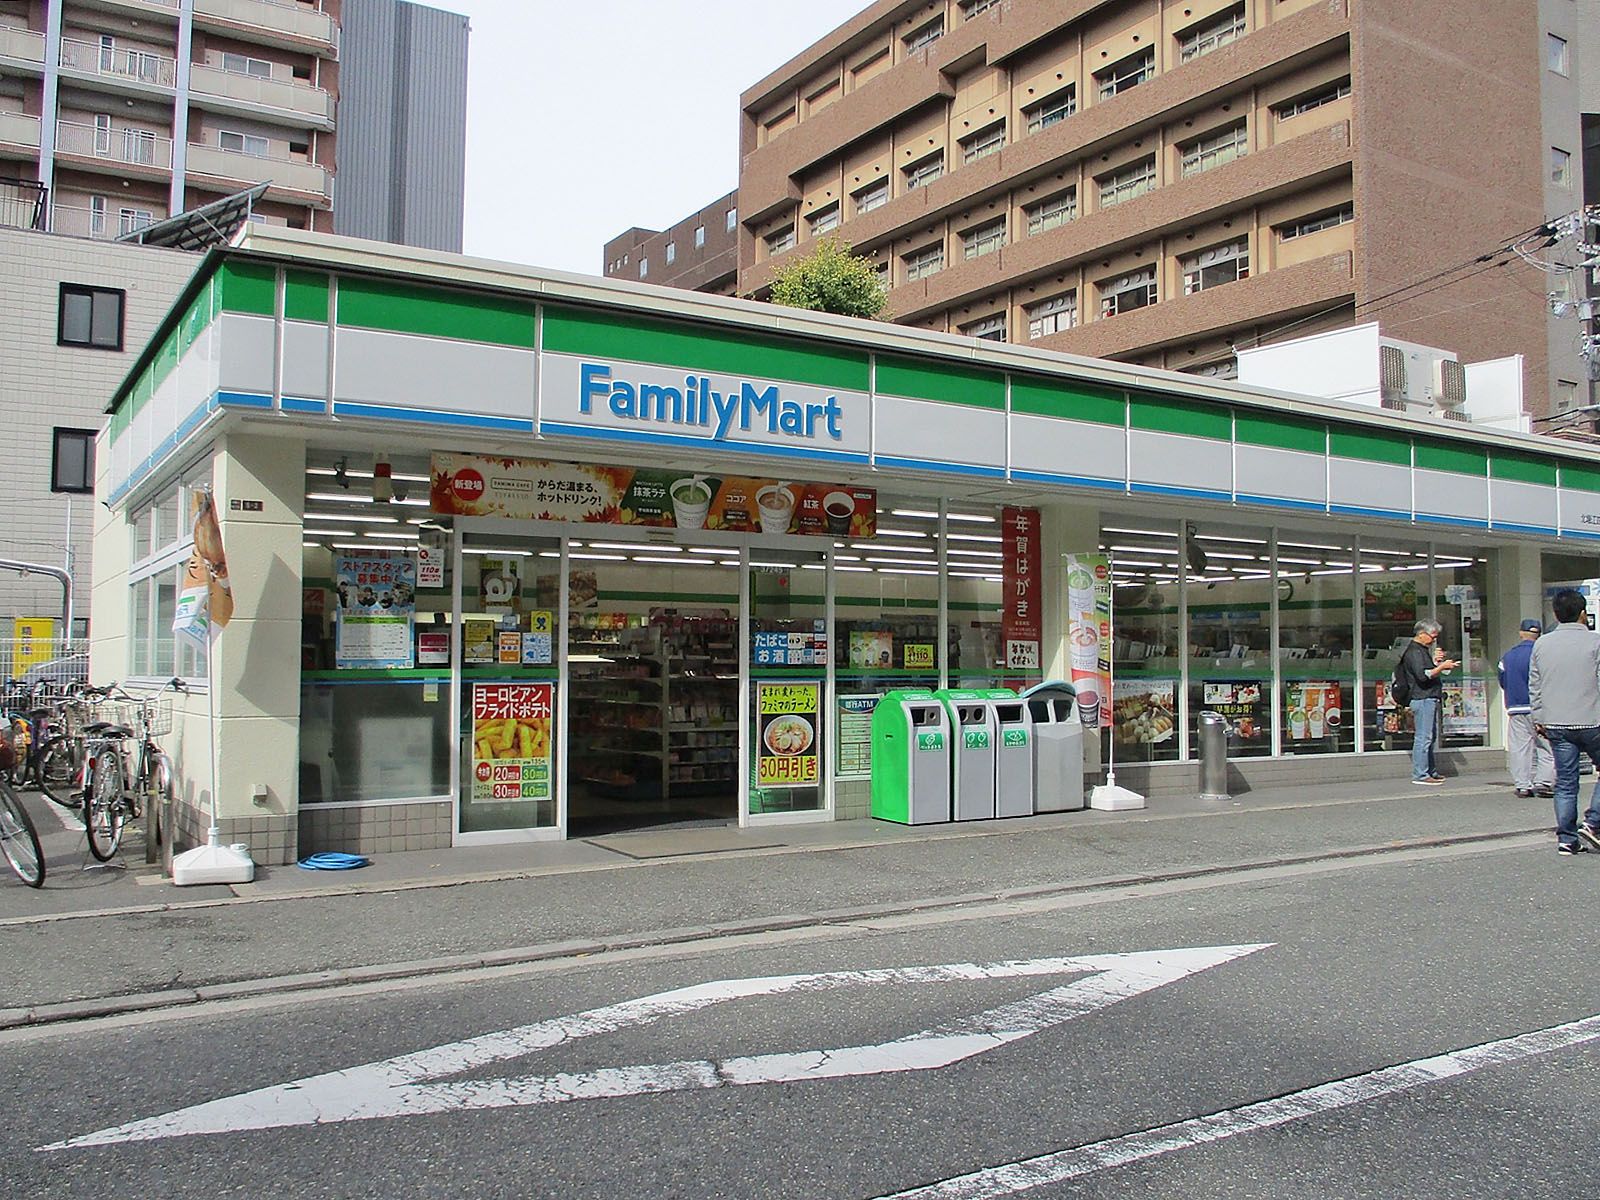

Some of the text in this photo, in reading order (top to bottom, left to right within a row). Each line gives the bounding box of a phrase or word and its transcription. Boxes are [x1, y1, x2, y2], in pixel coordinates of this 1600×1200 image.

[578, 362, 842, 442] FamilyMart
[633, 486, 666, 498] 抹茶ラテ
[726, 494, 747, 504] ココア
[1015, 514, 1030, 618] 年賀はがき
[755, 633, 788, 647] たばこ
[758, 649, 785, 663] お酒
[476, 686, 543, 702] ヨーロピアン
[476, 702, 550, 718] フライドポテト
[761, 698, 817, 712] ファミマのラーメン
[760, 756, 816, 778] 50円引き
